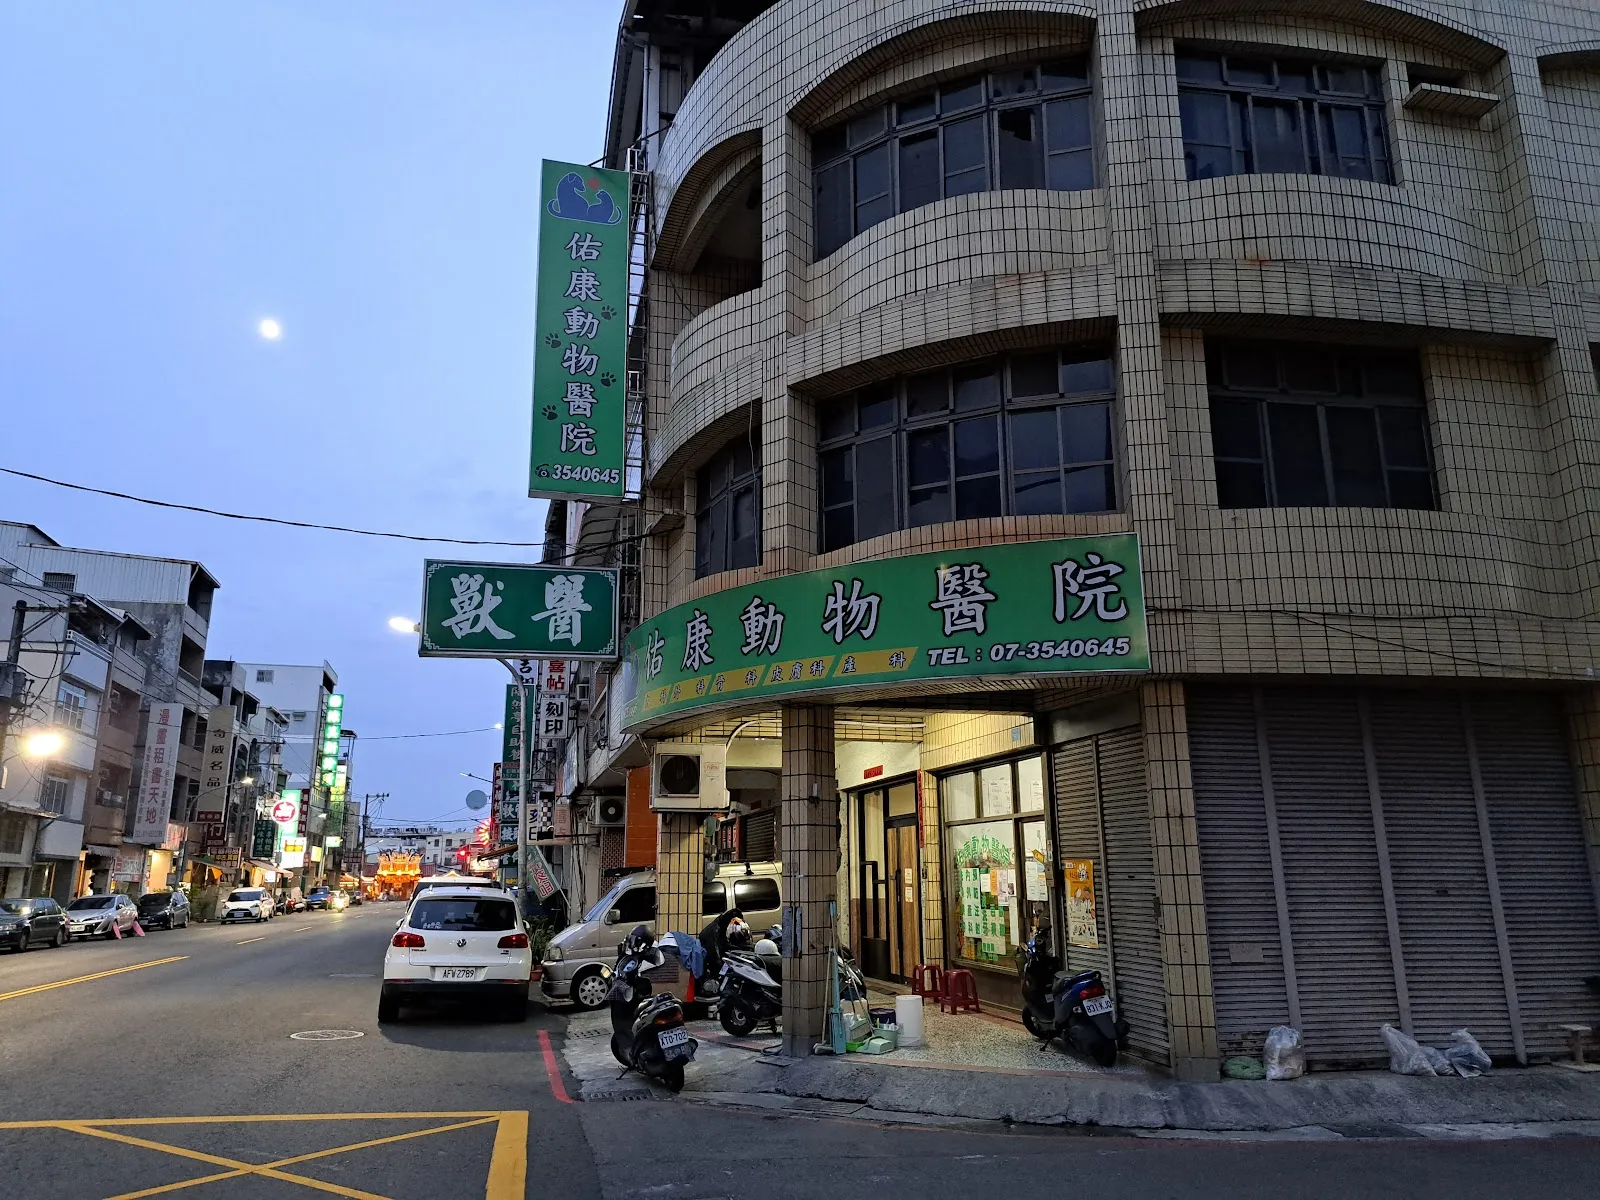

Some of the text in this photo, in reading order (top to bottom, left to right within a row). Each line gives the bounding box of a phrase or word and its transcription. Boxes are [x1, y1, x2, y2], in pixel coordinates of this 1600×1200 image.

[560, 231, 603, 456] 佑康動物醫院
[551, 463, 620, 484] 3540645
[441, 573, 593, 647] 獸醫
[645, 552, 1128, 682] 佑康動物醫院
[989, 637, 1131, 661] 07-3540645
[545, 701, 564, 735] 刻印
[207, 728, 225, 787] 奇威名品
